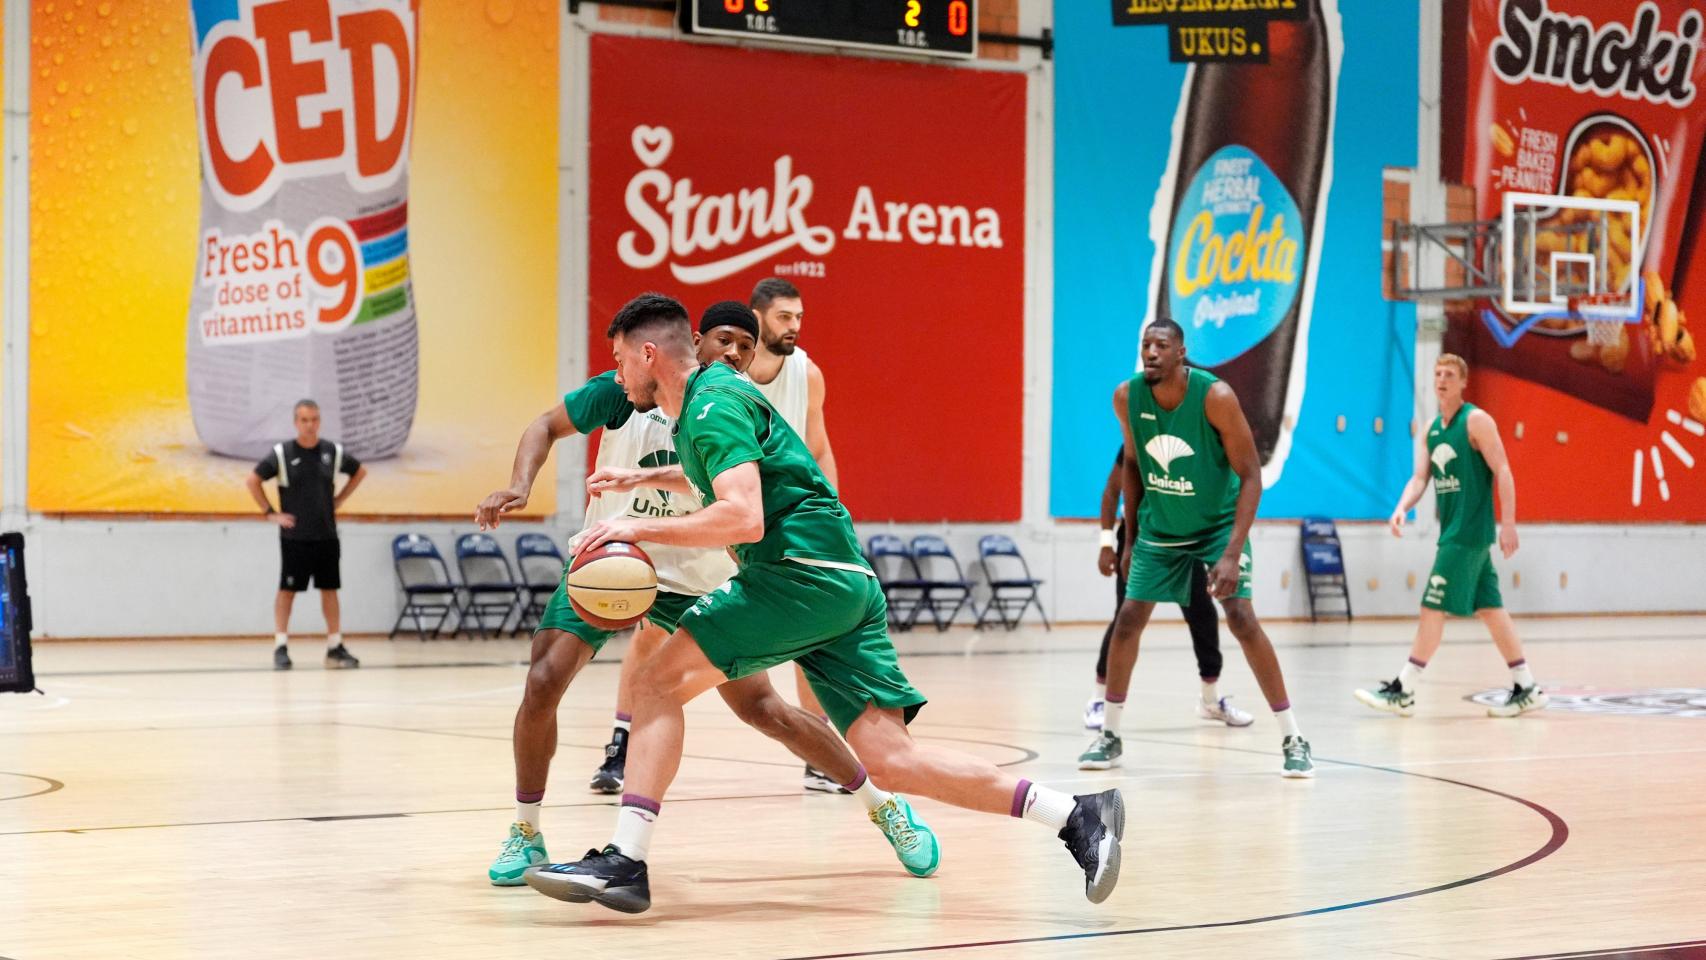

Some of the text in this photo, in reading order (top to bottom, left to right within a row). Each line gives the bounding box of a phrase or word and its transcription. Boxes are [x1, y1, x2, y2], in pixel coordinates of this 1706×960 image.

[948, 0, 968, 36] 0
[1179, 26, 1261, 56] UKUS.
[1491, 0, 1699, 104] Smoki
[1520, 127, 1558, 154] FRESH
[1516, 147, 1556, 174] BAKED
[1501, 165, 1553, 194] PEANUTS
[843, 186, 1003, 248] Arena
[206, 228, 299, 278] Fresh
[1174, 204, 1298, 297] Cockta
[218, 273, 302, 306] dose of
[306, 225, 358, 324] 9
[203, 307, 305, 337] vitamins
[1193, 287, 1262, 329] Original
[647, 412, 667, 426] oma
[1148, 472, 1194, 493] Unicaja
